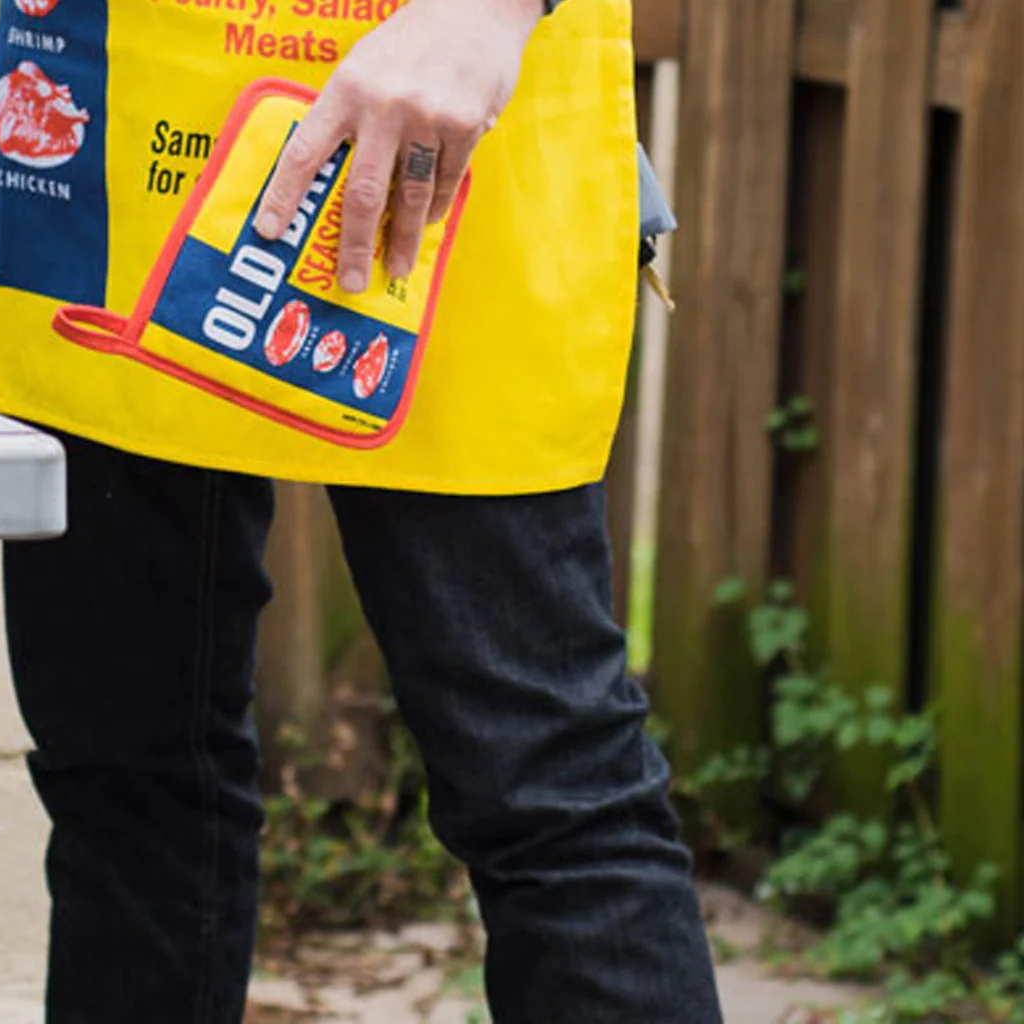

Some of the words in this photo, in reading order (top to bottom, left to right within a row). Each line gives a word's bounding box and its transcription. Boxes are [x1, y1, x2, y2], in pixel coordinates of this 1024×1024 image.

[224, 23, 338, 63] Meats
[151, 120, 218, 160] Sam
[147, 160, 187, 195] for
[202, 244, 287, 351] OLD
